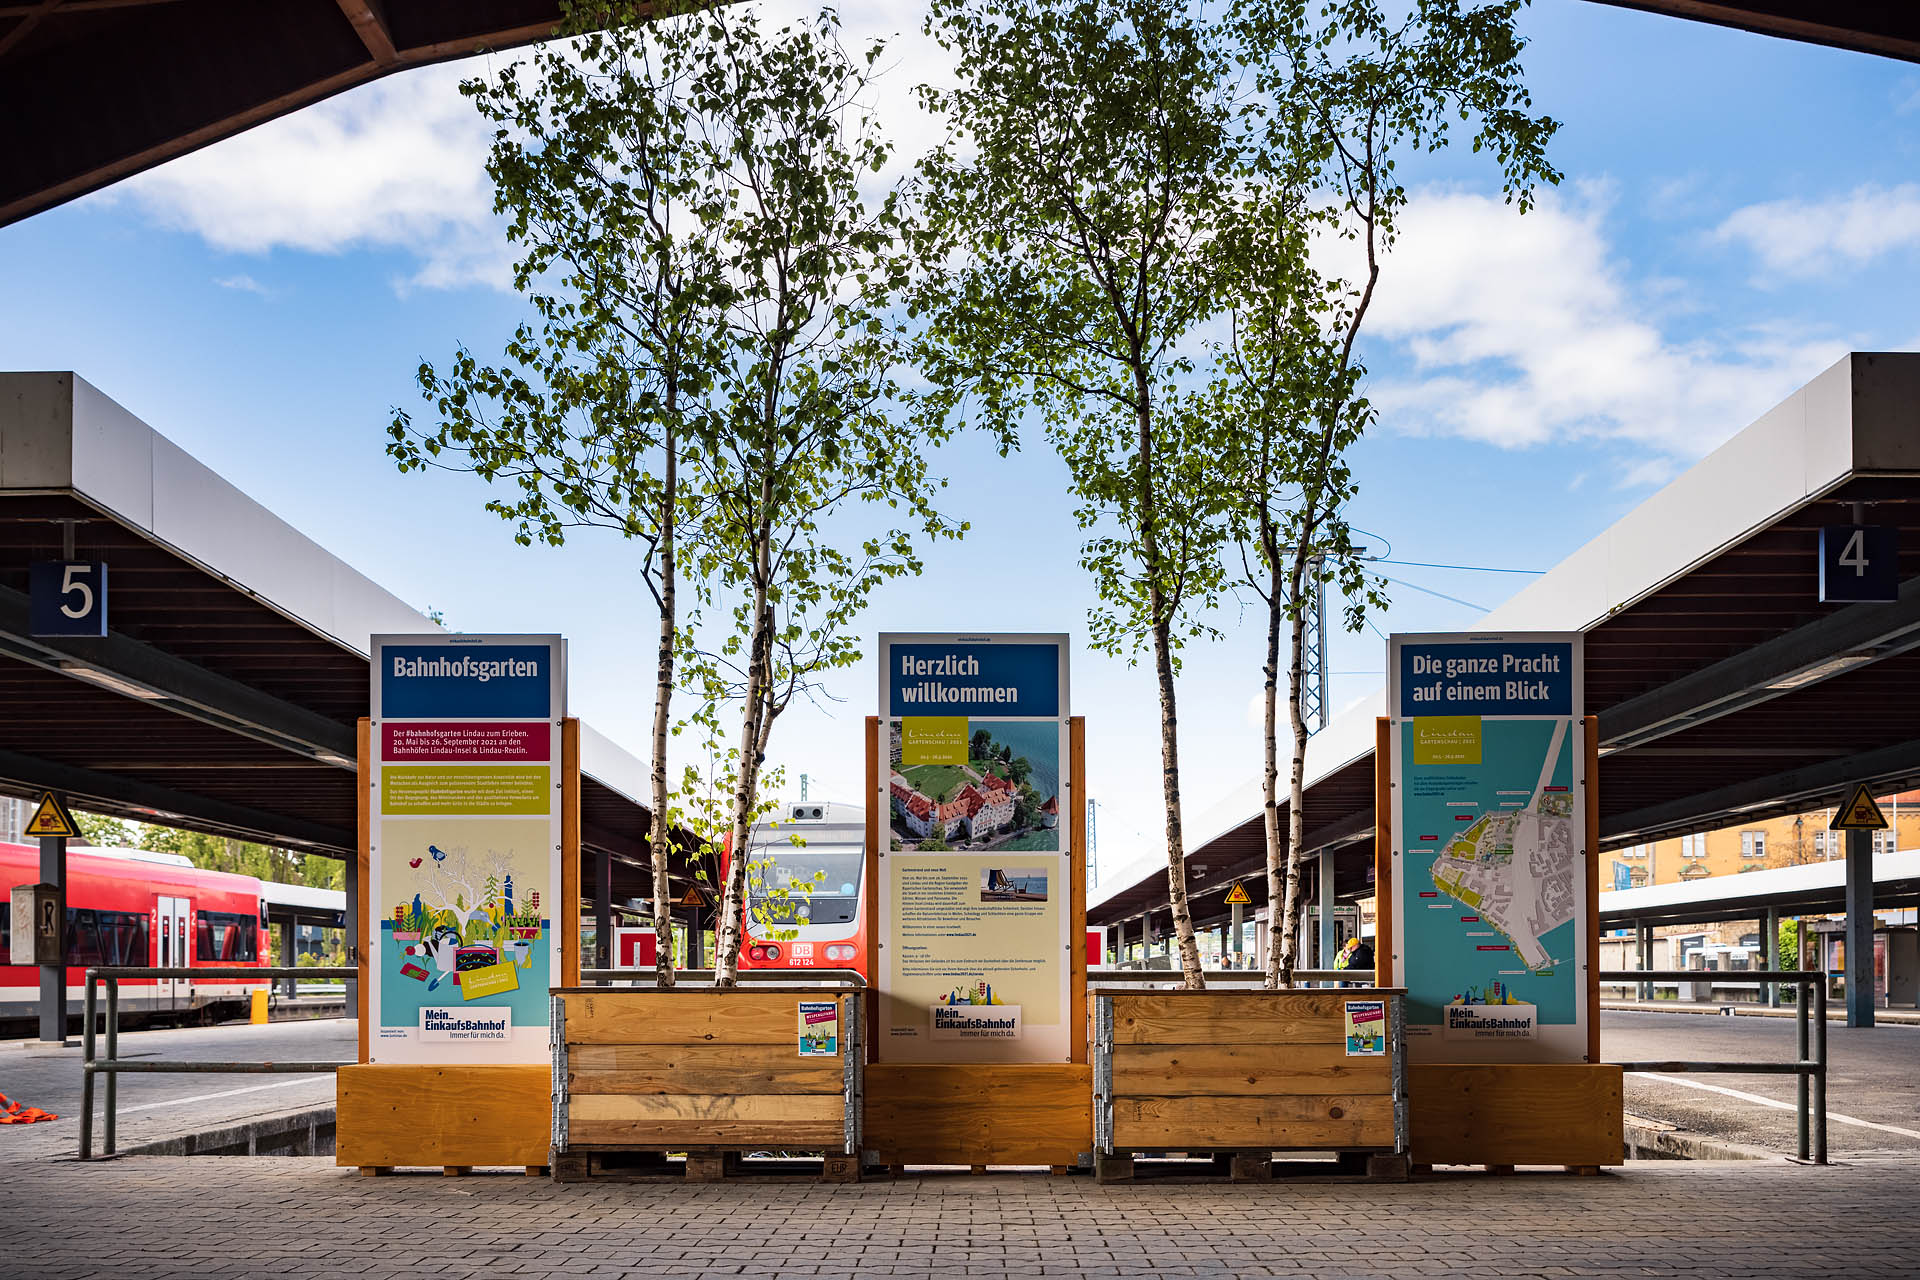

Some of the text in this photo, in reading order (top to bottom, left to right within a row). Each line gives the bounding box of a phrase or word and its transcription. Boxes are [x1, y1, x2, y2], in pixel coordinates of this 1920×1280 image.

[1838, 530, 1869, 577] 4
[60, 565, 94, 619] 5
[393, 656, 538, 682] Bahnhofsgarten
[902, 655, 979, 676] Herzlich
[1413, 654, 1560, 678] Die ganze Pracht
[902, 682, 1018, 703] willkommen
[1413, 681, 1550, 702] auf einem Blick
[406, 730, 462, 739] #bahnhofsgarten
[406, 738, 419, 746] Mai
[420, 738, 430, 746] bis
[431, 738, 442, 746] 26.
[443, 738, 480, 747] September
[509, 738, 521, 746] den
[393, 746, 429, 754] Bahnhöfen
[430, 746, 471, 754] Lindau-Insel
[480, 746, 528, 754] Lindau-Reutin.
[151, 909, 157, 923] 2
[191, 912, 196, 926] 2
[336, 912, 343, 923] 7
[794, 945, 811, 956] DB
[425, 1009, 454, 1020] Mein_
[935, 1008, 965, 1019] Mein_
[1450, 1008, 1479, 1018] Mein_
[425, 1020, 506, 1031] EinkaufsBahnhof
[935, 1018, 1016, 1029] EinkaufsBahnhof
[1450, 1018, 1531, 1029] EinkaufsBahnhof
